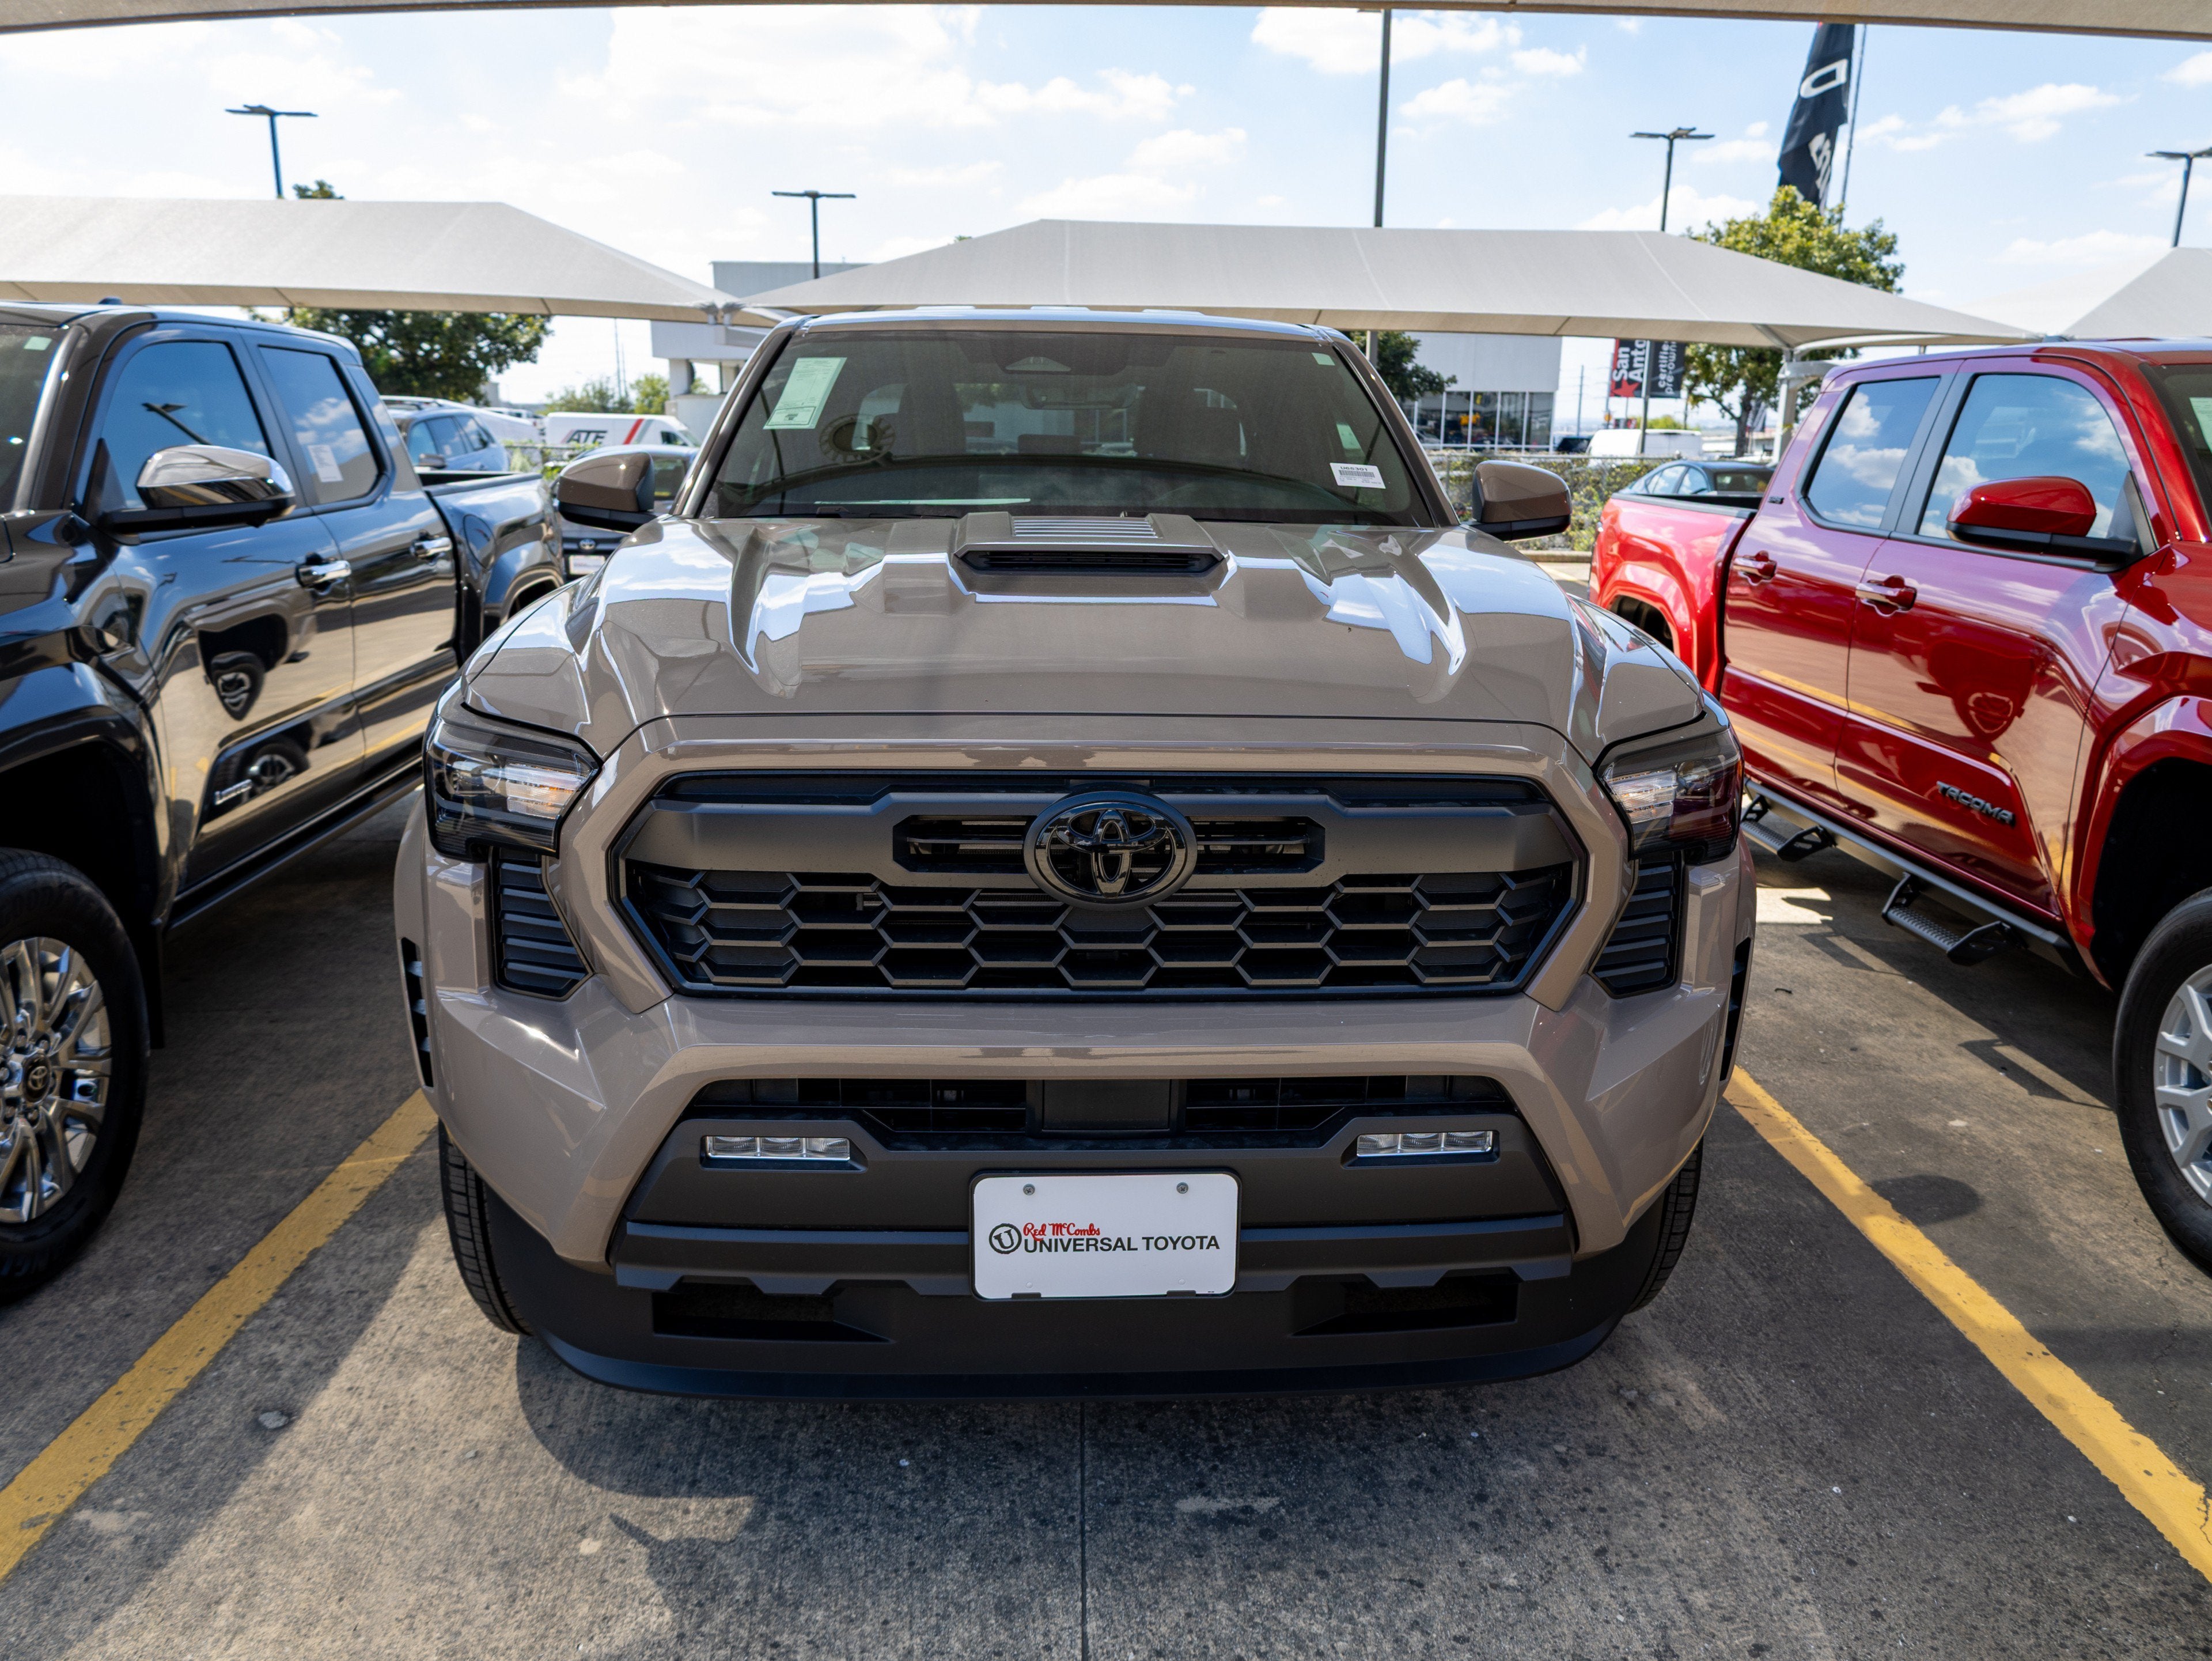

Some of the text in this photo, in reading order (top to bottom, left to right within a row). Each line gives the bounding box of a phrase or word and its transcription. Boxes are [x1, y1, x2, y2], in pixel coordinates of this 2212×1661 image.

[1612, 347, 1631, 382] San
[1936, 780, 2014, 825] TACOMA
[1023, 1222, 1101, 1242] Red McCombs
[1024, 1235, 1221, 1253] UNIVERSAL TOYOTA
